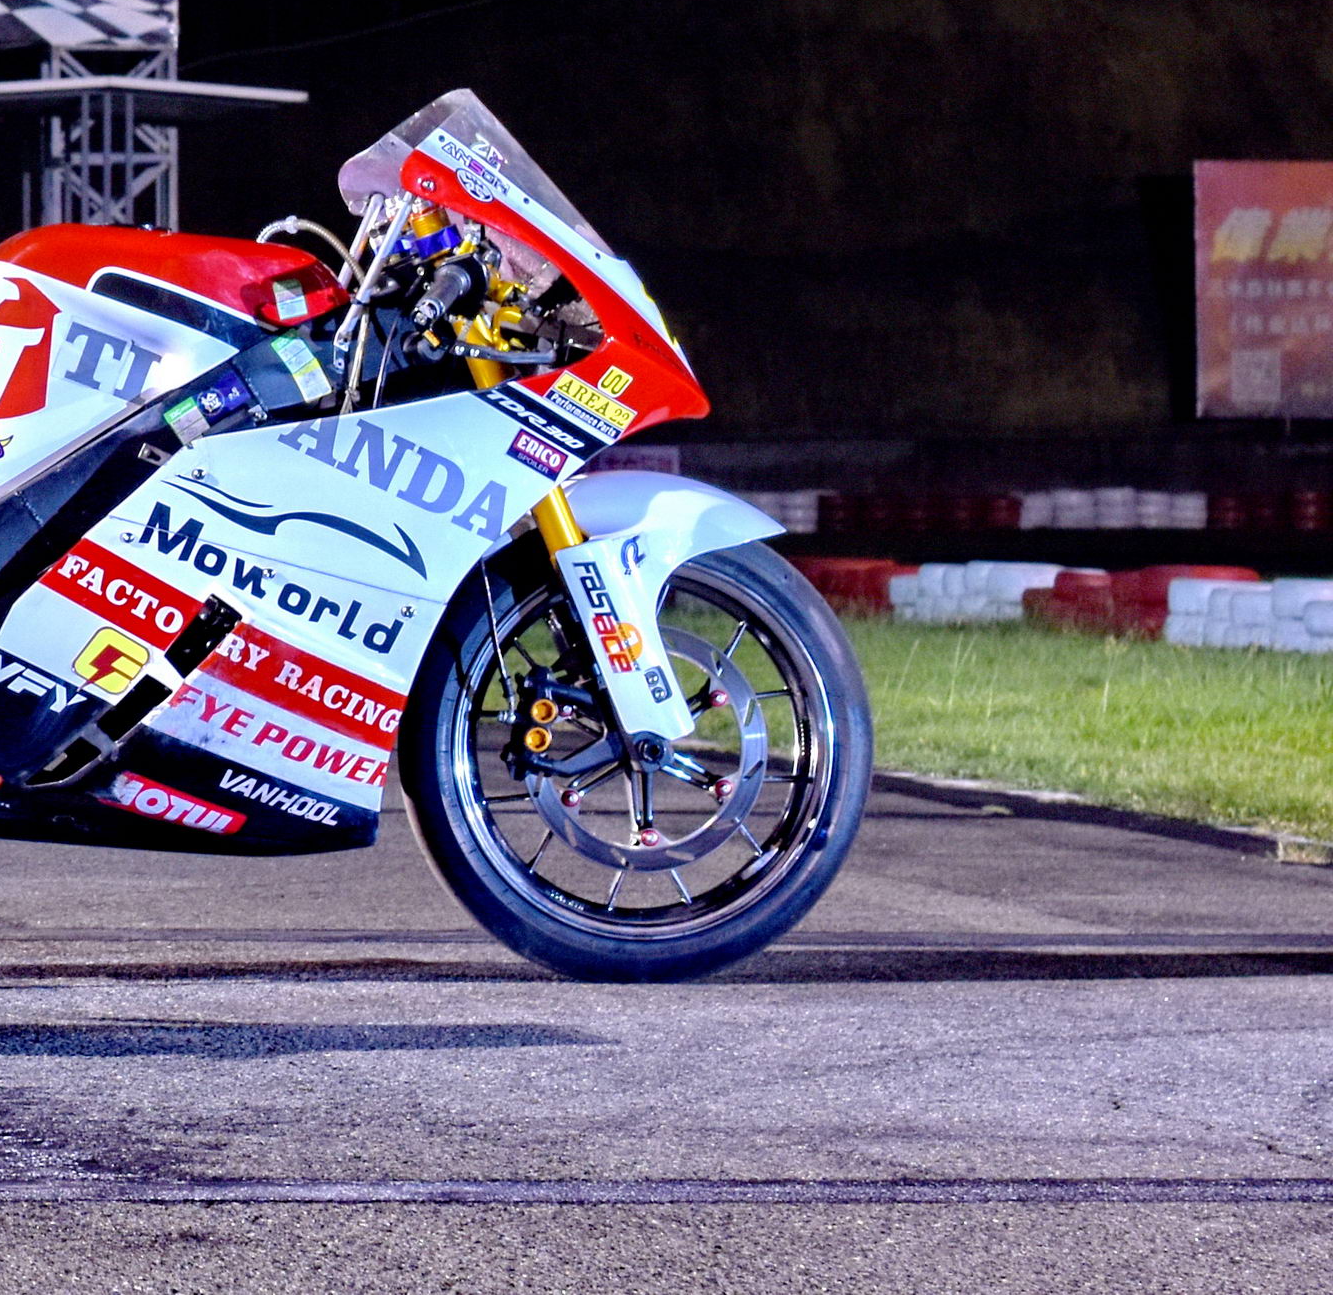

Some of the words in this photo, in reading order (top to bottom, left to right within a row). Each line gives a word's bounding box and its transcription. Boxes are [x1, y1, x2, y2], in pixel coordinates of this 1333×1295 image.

[550, 391, 600, 428] Performance
[595, 418, 617, 438] Parts
[558, 379, 611, 417] AREA
[609, 407, 631, 428] 22
[516, 434, 562, 469] ERICO
[279, 418, 511, 540] ANDA
[56, 552, 185, 636] FACTO
[216, 631, 271, 676] RY
[274, 655, 401, 735] RACING
[218, 768, 339, 826] VANHOOL
